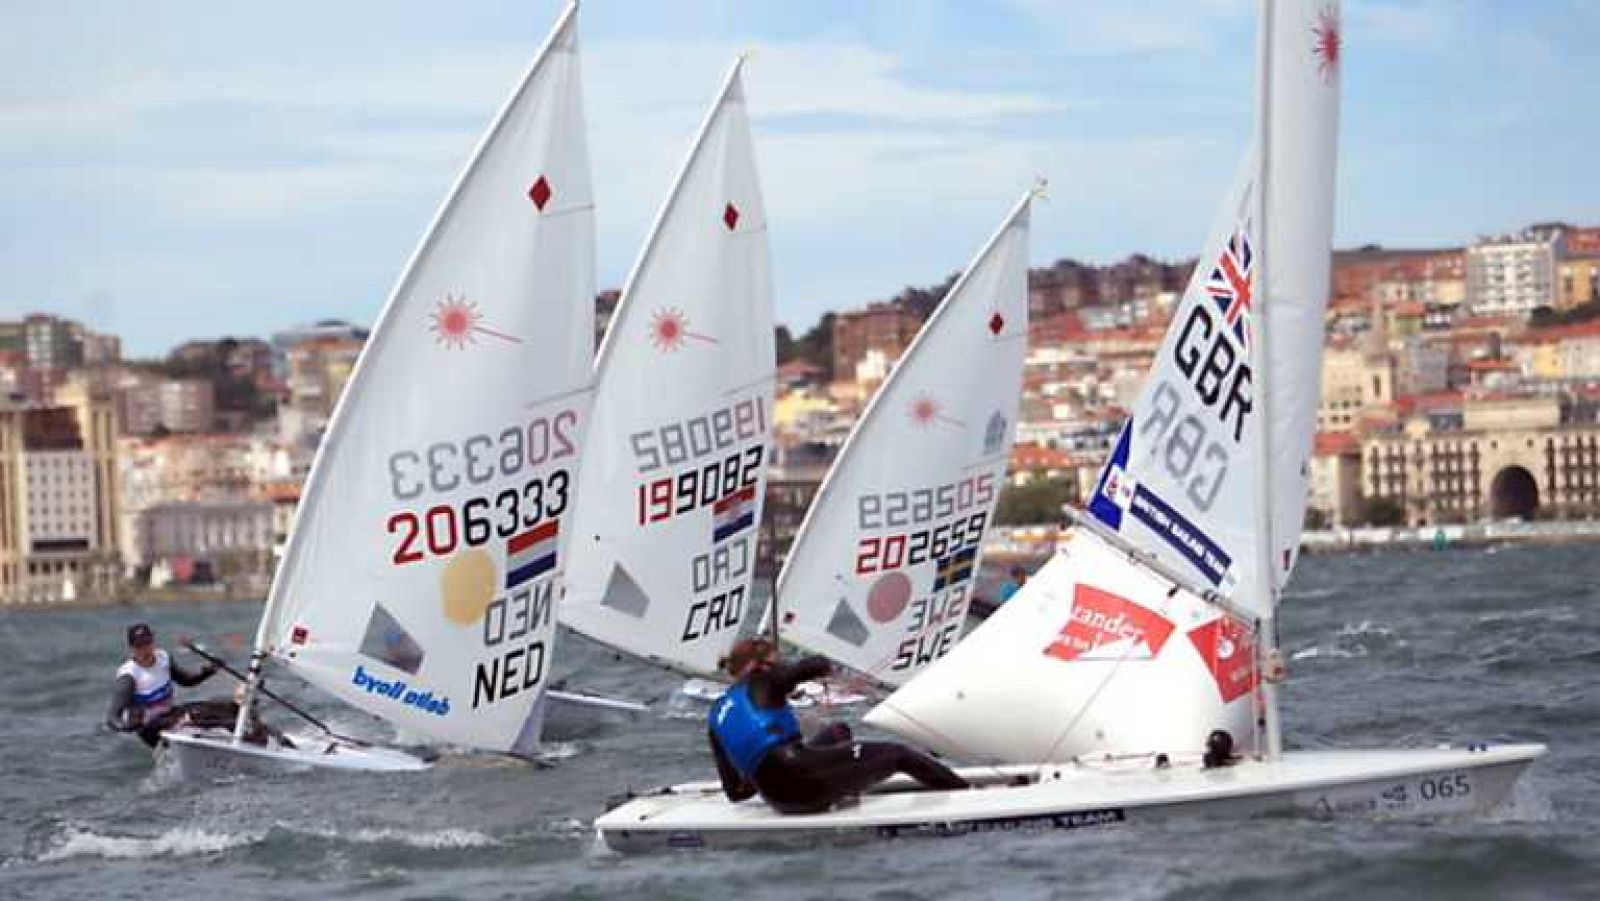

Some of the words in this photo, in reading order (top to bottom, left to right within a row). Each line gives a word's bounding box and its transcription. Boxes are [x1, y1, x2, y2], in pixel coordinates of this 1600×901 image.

[1173, 303, 1252, 442] GBR
[387, 469, 570, 563] 206333
[639, 444, 764, 526] 199082
[856, 511, 987, 574] 202659
[682, 585, 745, 642] CRO
[472, 641, 545, 710] NED
[892, 624, 958, 671] SWE
[1420, 773, 1470, 800] 065
